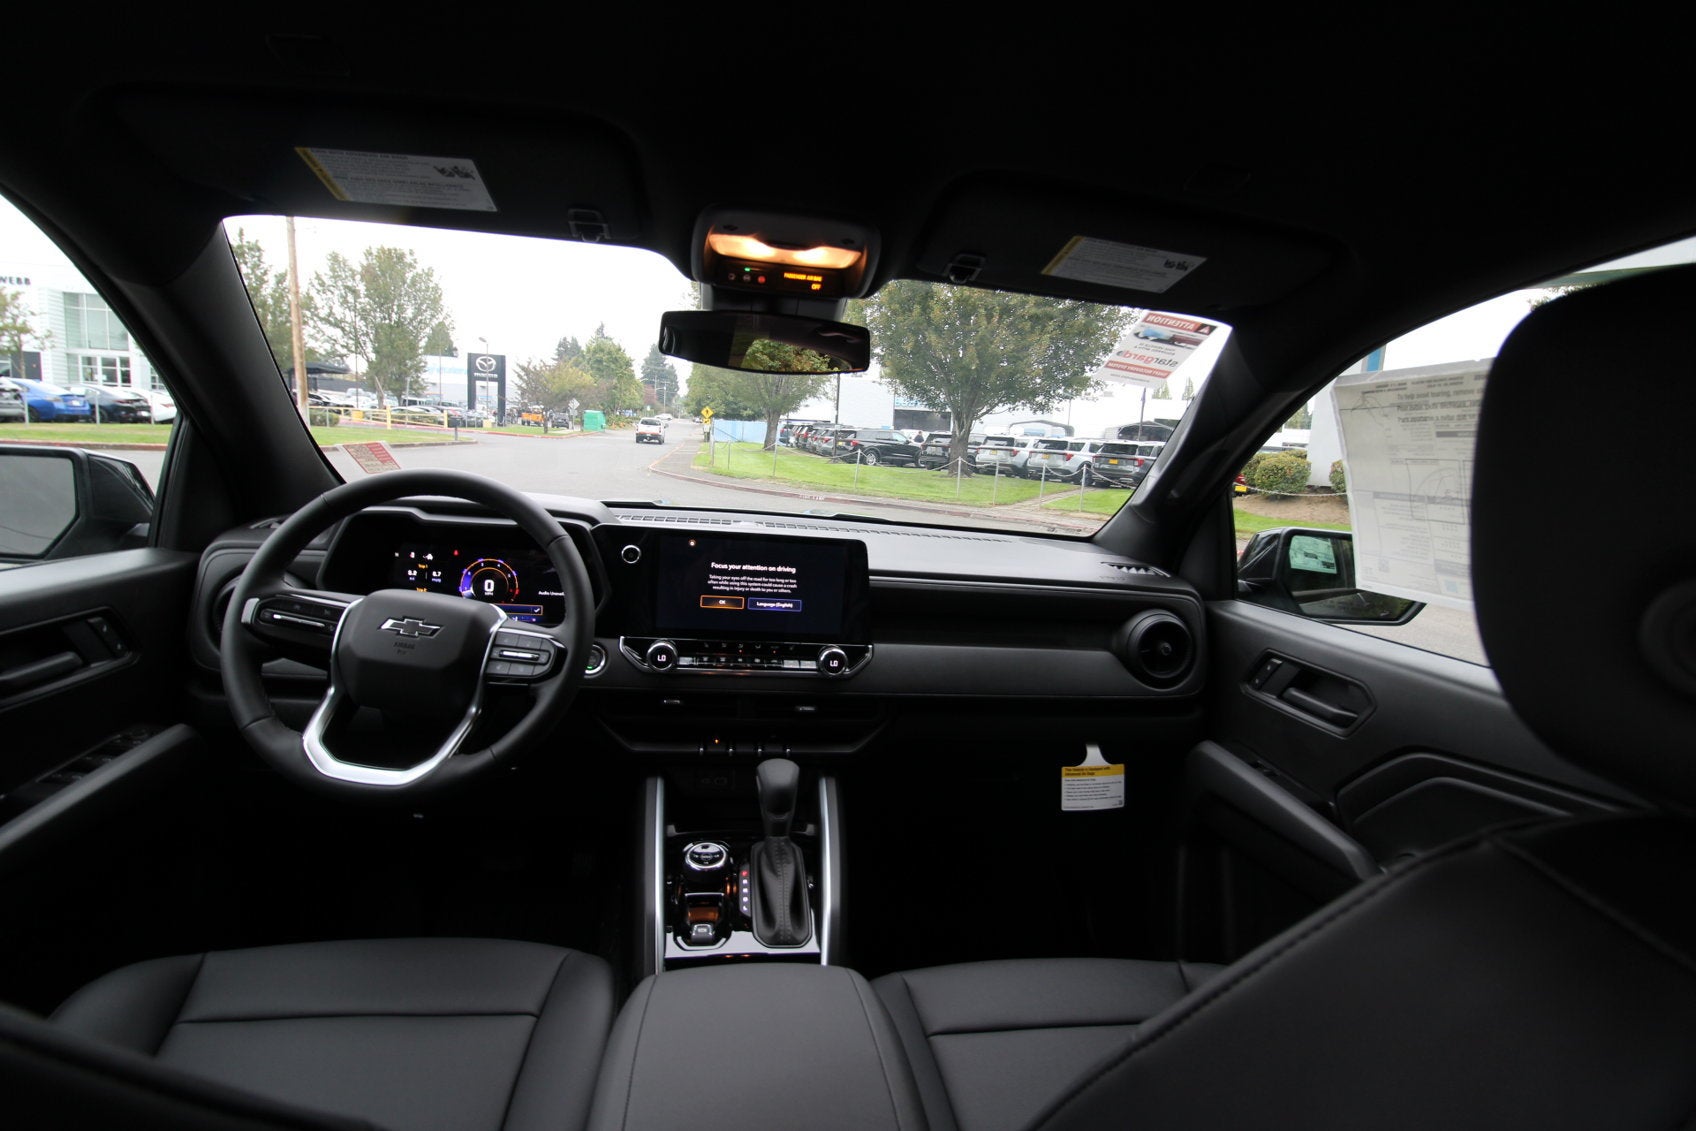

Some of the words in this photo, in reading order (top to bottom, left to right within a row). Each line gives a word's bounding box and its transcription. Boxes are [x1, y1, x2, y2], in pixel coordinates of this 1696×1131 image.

[777, 565, 796, 574] driving
[484, 579, 495, 591] 0
[756, 600, 776, 608] Language
